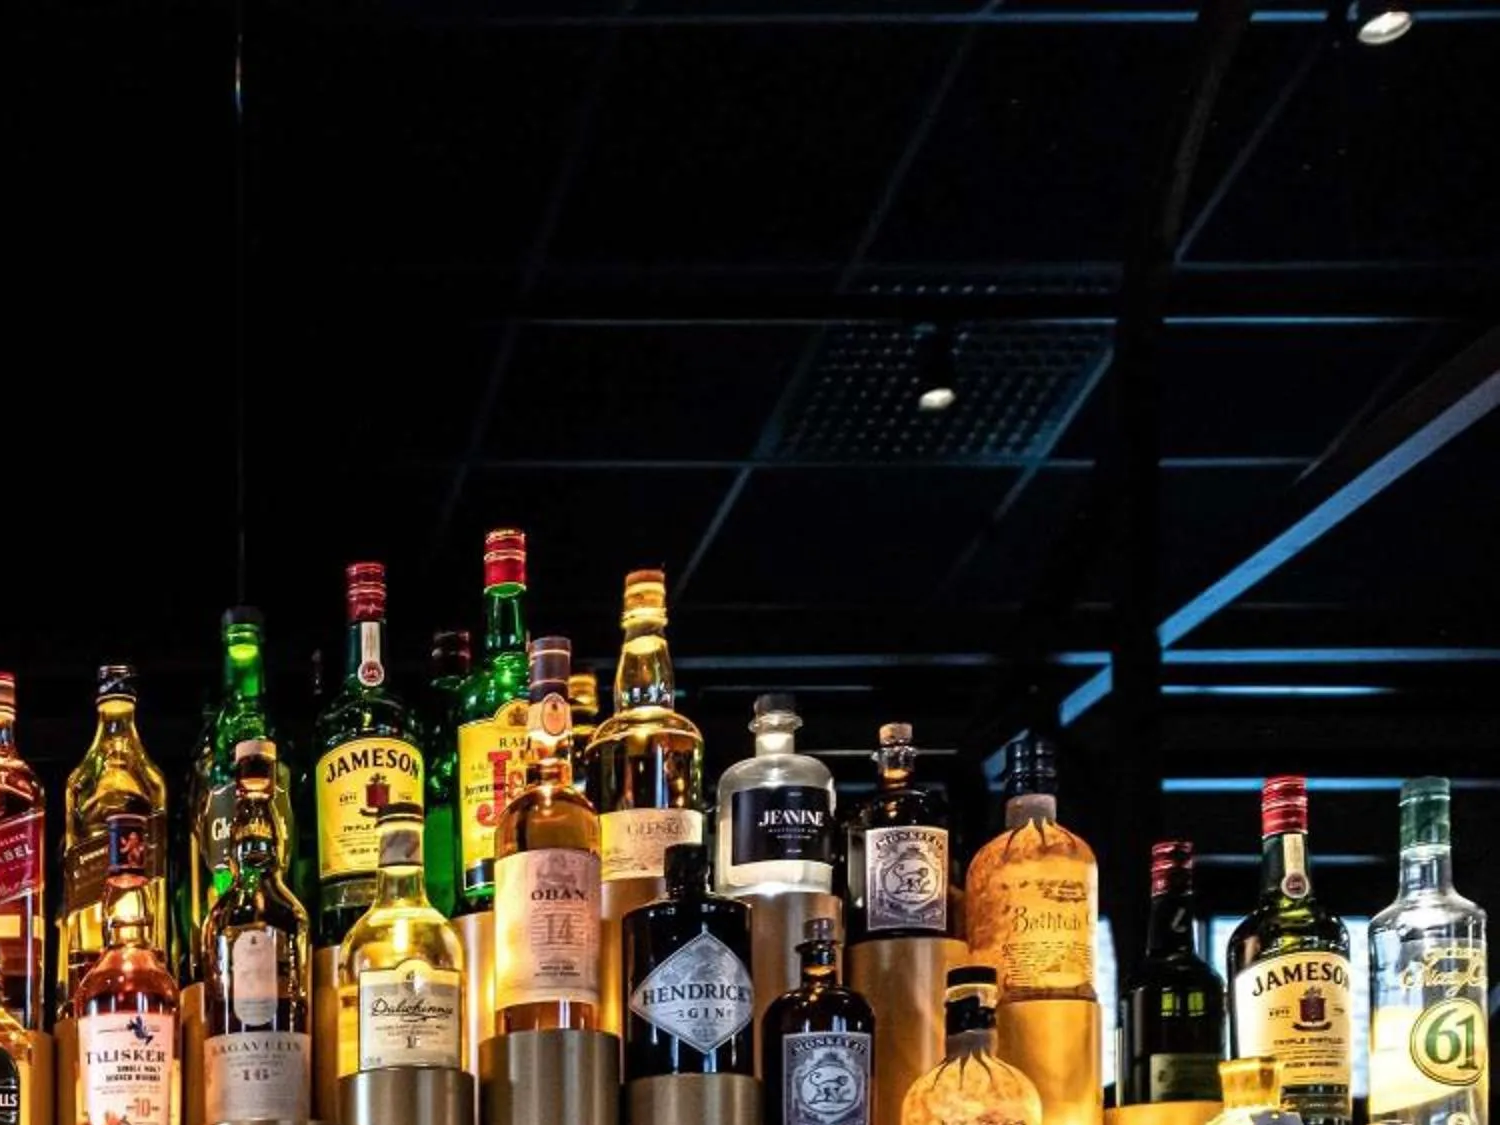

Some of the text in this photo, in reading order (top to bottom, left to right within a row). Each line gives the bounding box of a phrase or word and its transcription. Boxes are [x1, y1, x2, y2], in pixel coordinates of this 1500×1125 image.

[325, 749, 421, 783] JAMESON
[531, 888, 586, 901] OBAN
[687, 1006, 726, 1019] GIN
[1425, 1008, 1479, 1071] 61
[85, 1049, 166, 1065] TALISKER
